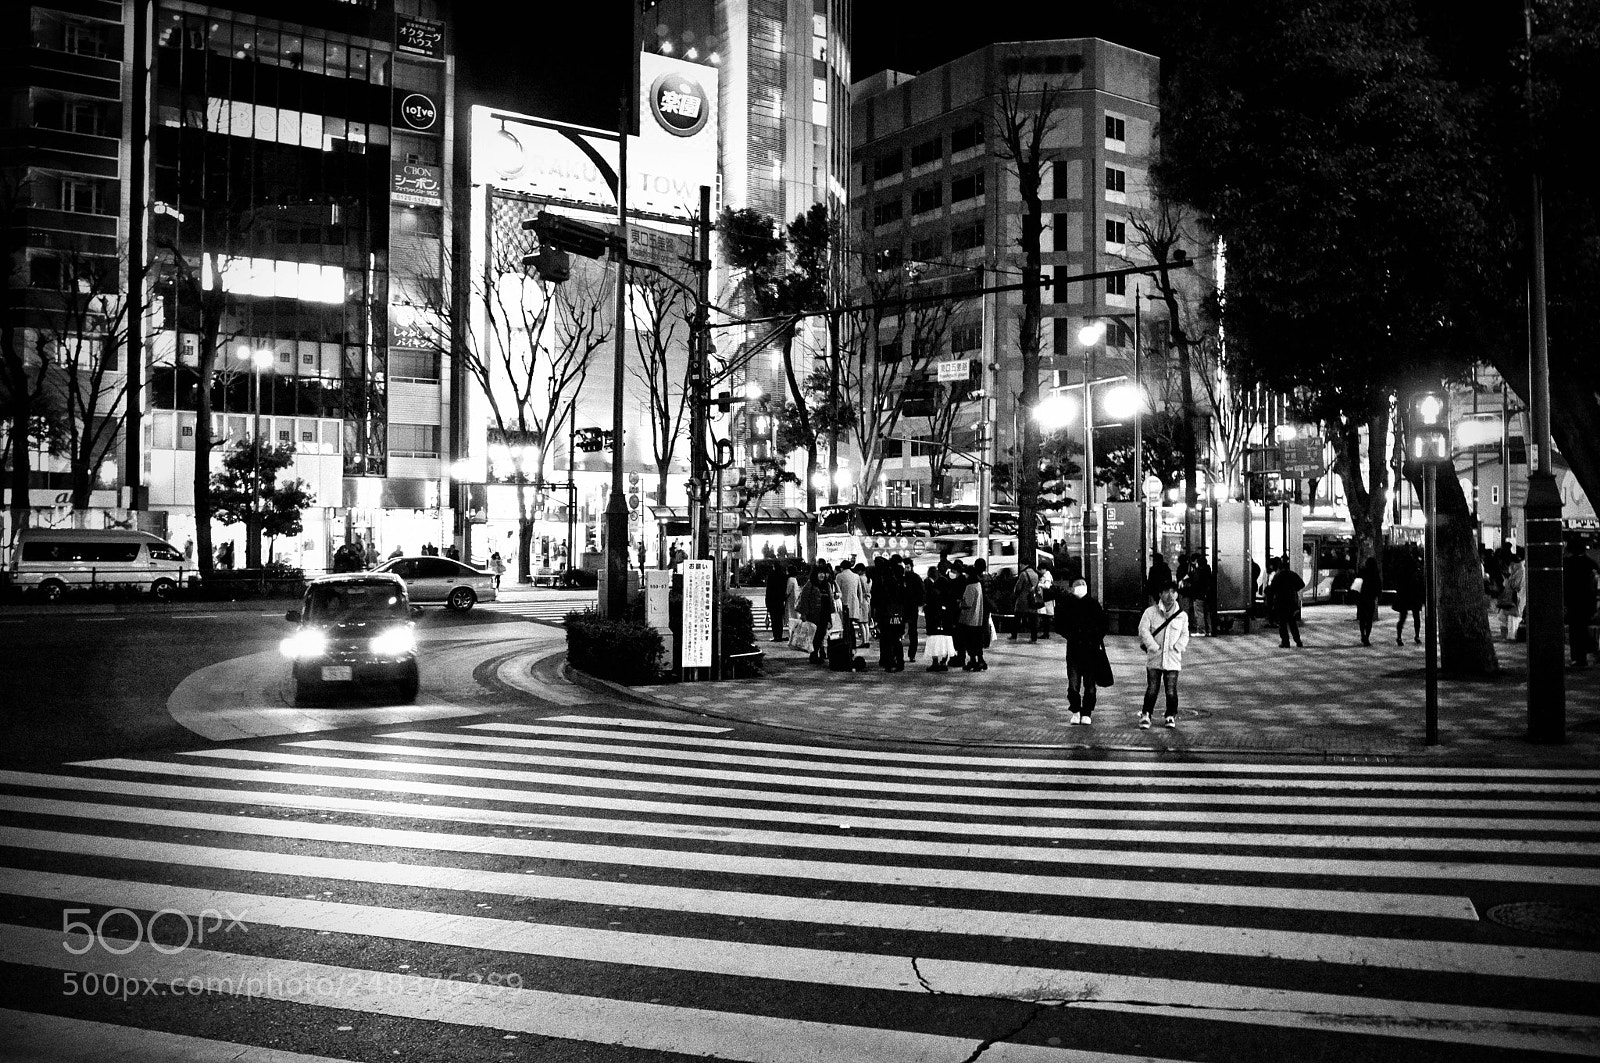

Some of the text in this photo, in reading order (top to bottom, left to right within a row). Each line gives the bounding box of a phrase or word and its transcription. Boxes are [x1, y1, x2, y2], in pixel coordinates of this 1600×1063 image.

[399, 26, 442, 42] オクターヴ
[407, 36, 433, 48] ハウス
[660, 90, 701, 118] 楽園
